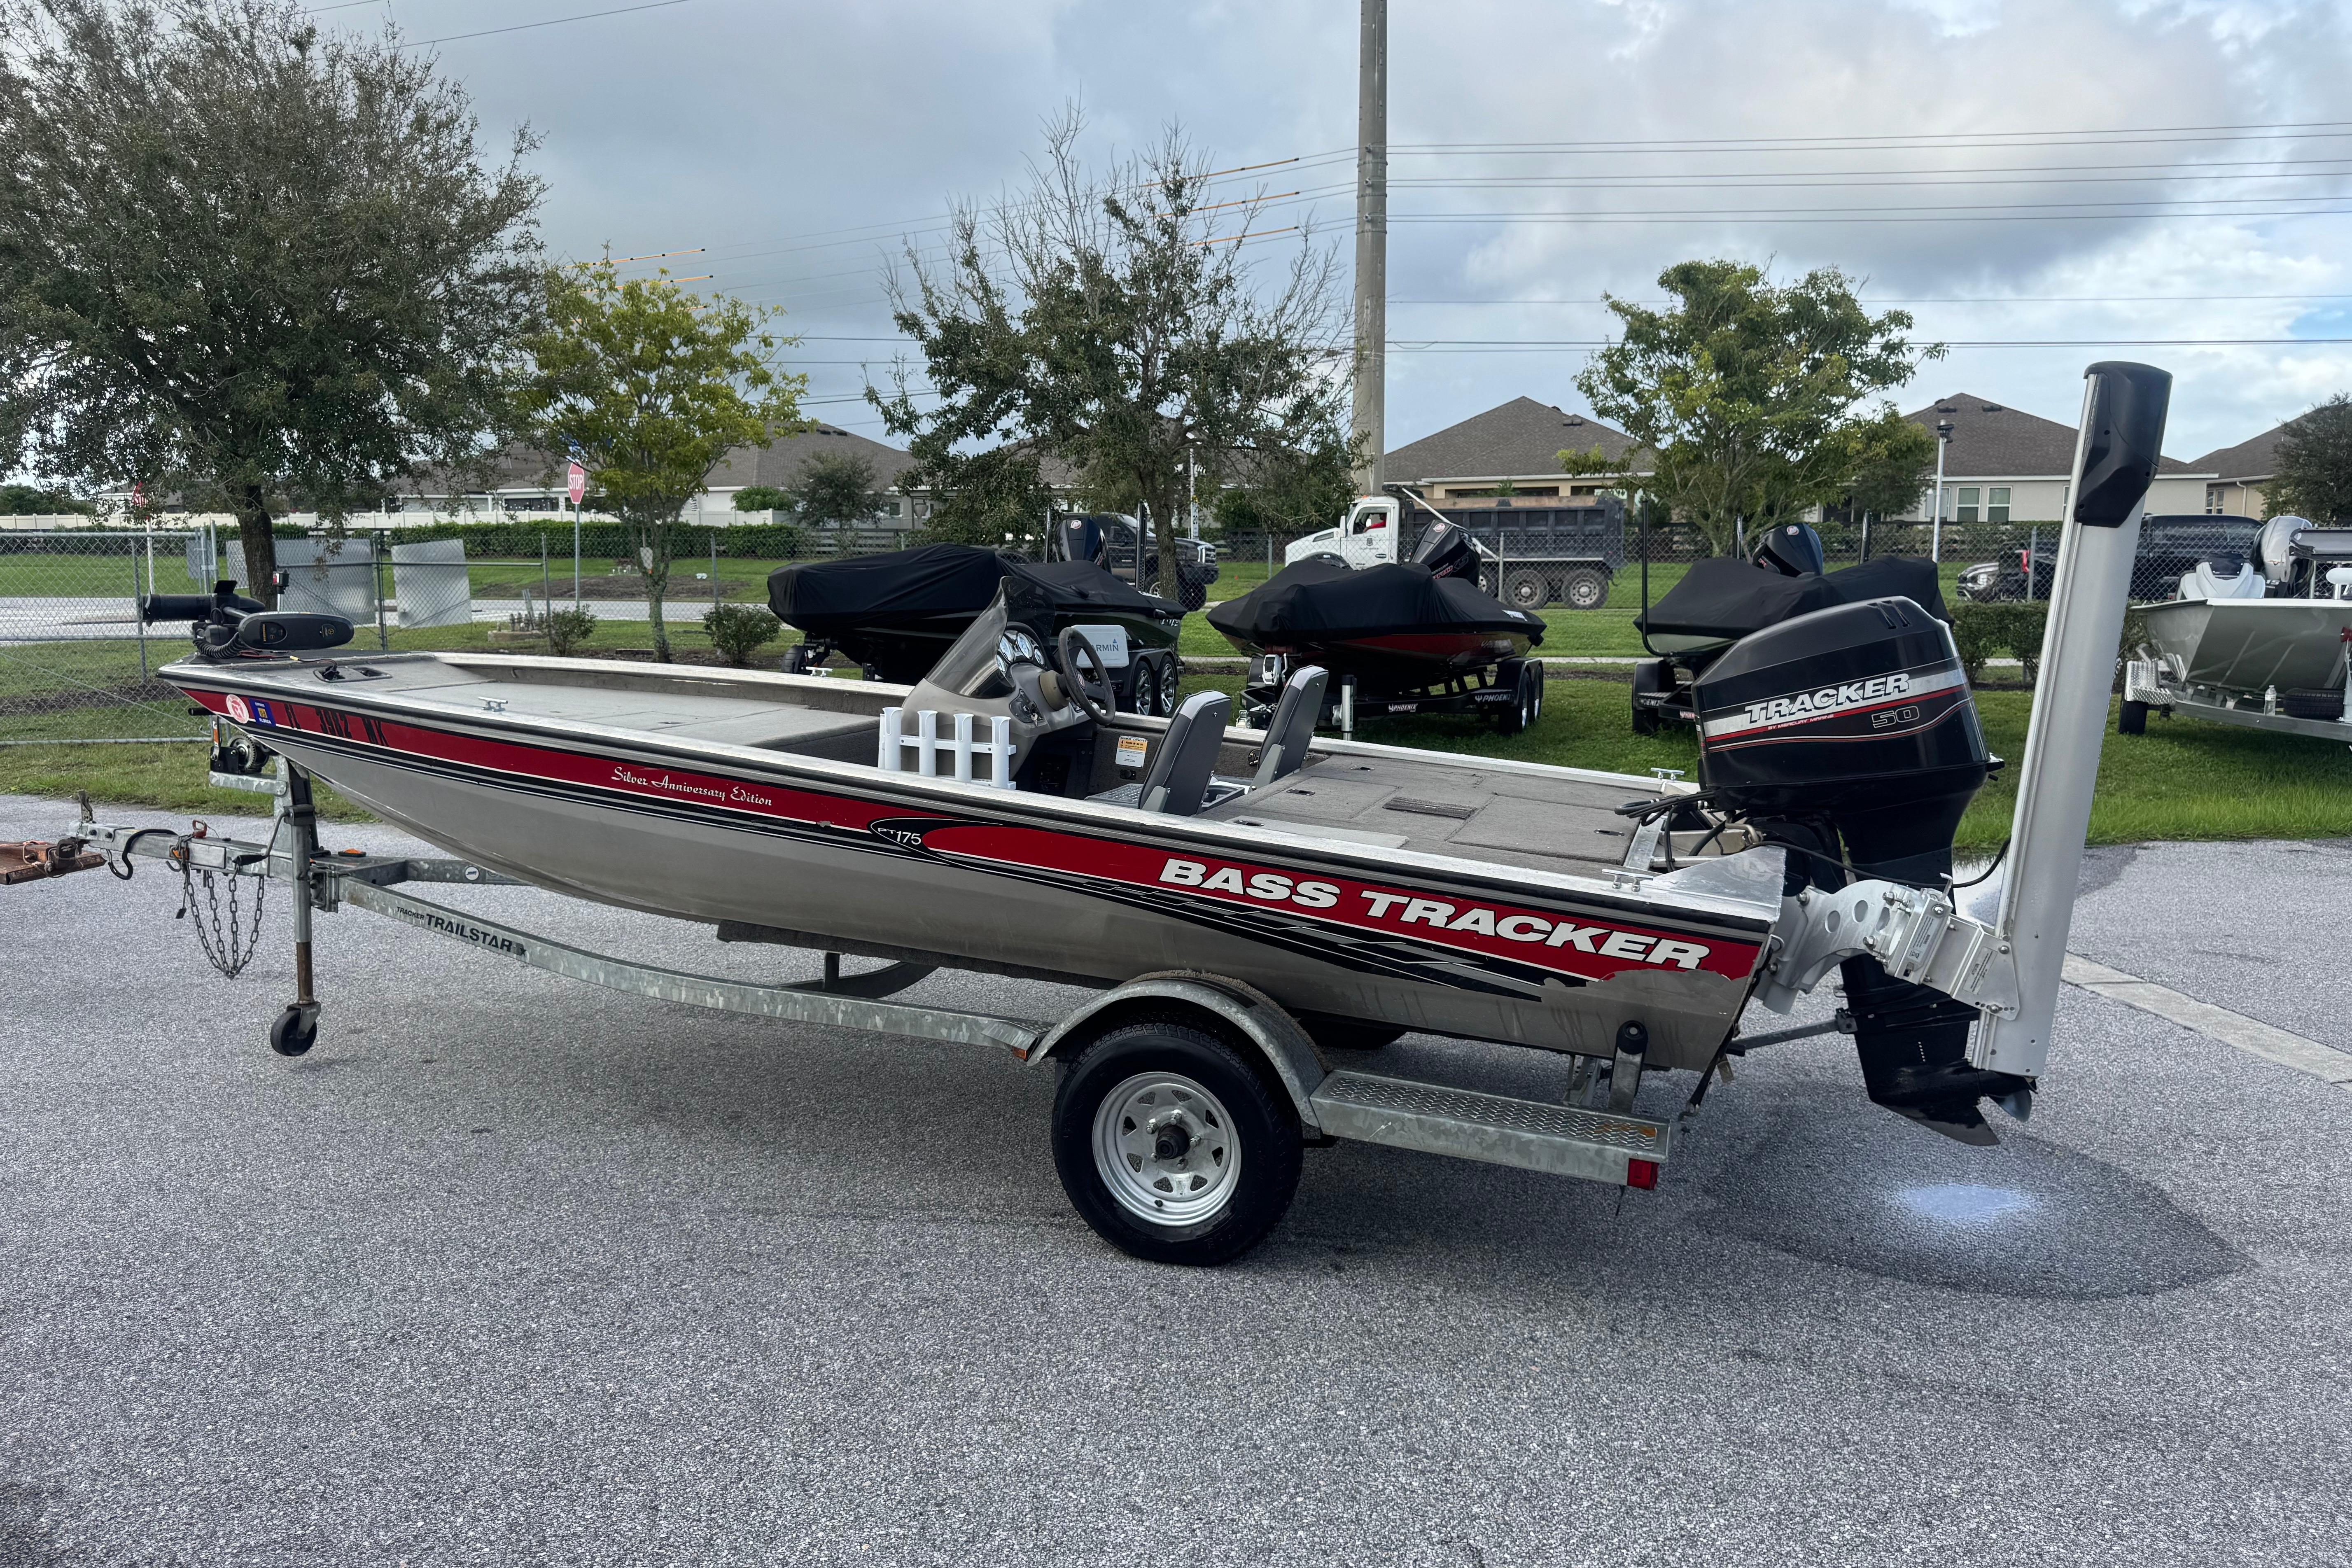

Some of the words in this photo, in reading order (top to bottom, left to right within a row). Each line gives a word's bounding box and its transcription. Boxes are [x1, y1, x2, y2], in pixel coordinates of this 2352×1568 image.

[569, 474, 583, 490] STOP
[1482, 693, 1511, 702] PHOENI
[1744, 673, 1909, 723] TRACKER
[1778, 719, 1808, 728] MERCURY
[1810, 714, 1834, 722] MARINE
[1871, 705, 1919, 728] 50
[611, 766, 648, 785] Silver
[651, 775, 726, 801] Anniversary
[730, 786, 772, 806] Edition
[397, 906, 425, 920] TRACKER
[426, 913, 513, 952] TRAILSTAR
[1158, 858, 1341, 908] BASS
[1360, 890, 1711, 970] TRACKER
